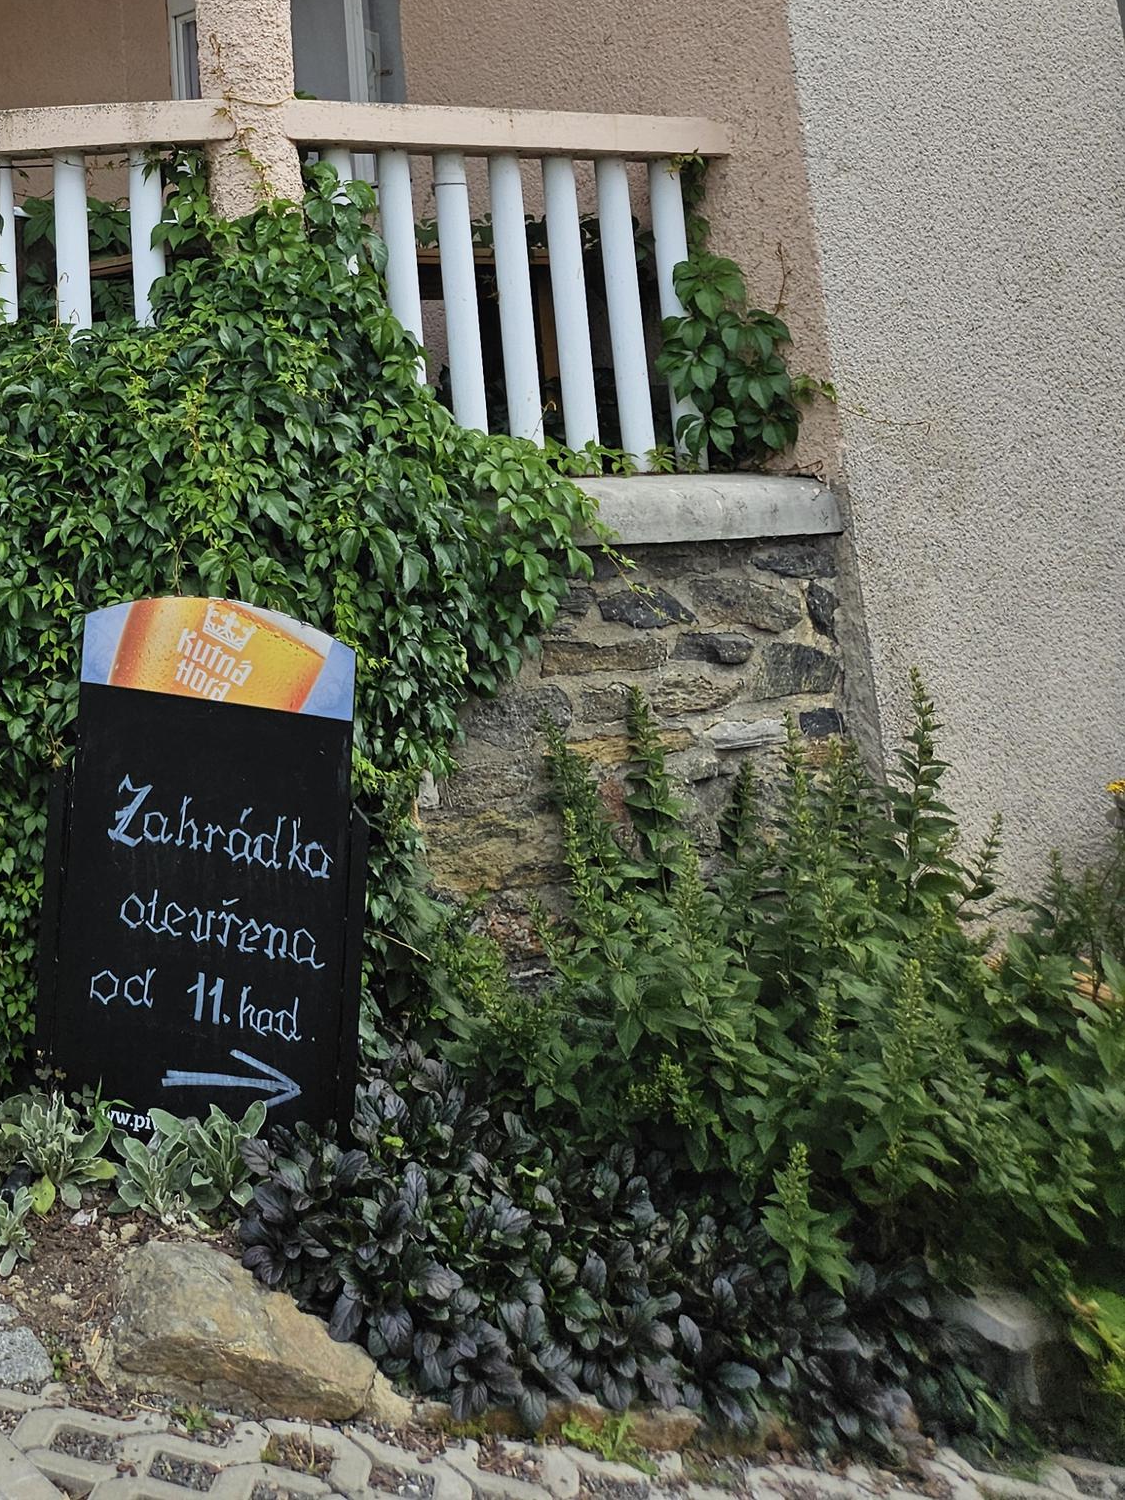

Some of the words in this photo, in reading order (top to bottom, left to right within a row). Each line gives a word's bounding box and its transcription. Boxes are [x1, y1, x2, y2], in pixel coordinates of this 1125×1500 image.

[107, 773, 334, 879] Zahrádka
[119, 888, 326, 970] otevřena
[89, 967, 157, 1008] od
